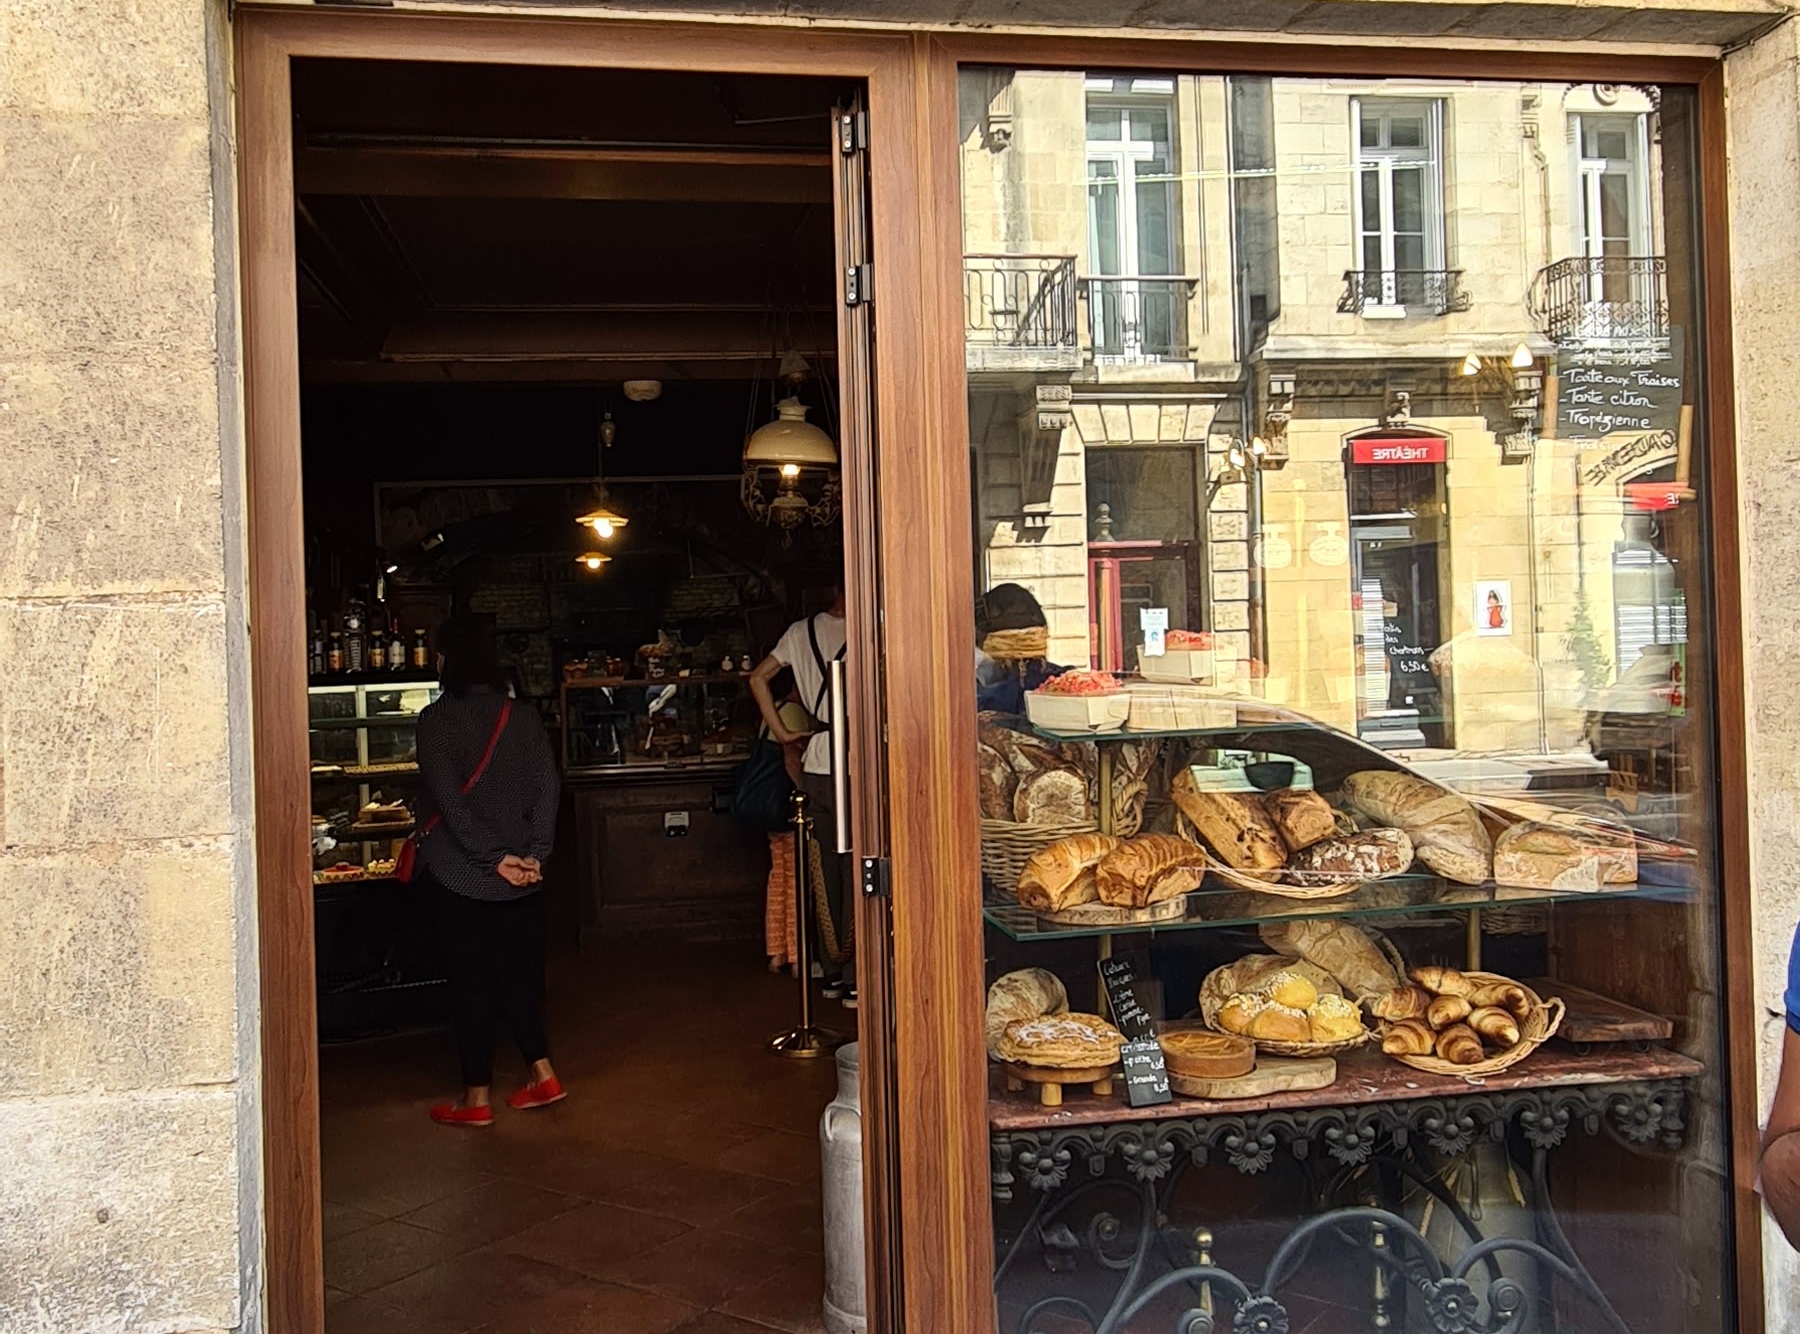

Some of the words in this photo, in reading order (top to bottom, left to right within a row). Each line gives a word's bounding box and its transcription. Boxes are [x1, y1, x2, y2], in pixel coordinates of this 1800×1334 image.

[1563, 368, 1603, 384] Tarte
[1604, 376, 1630, 386] aux
[1565, 386, 1605, 404] Tarte
[1610, 390, 1658, 408] citron
